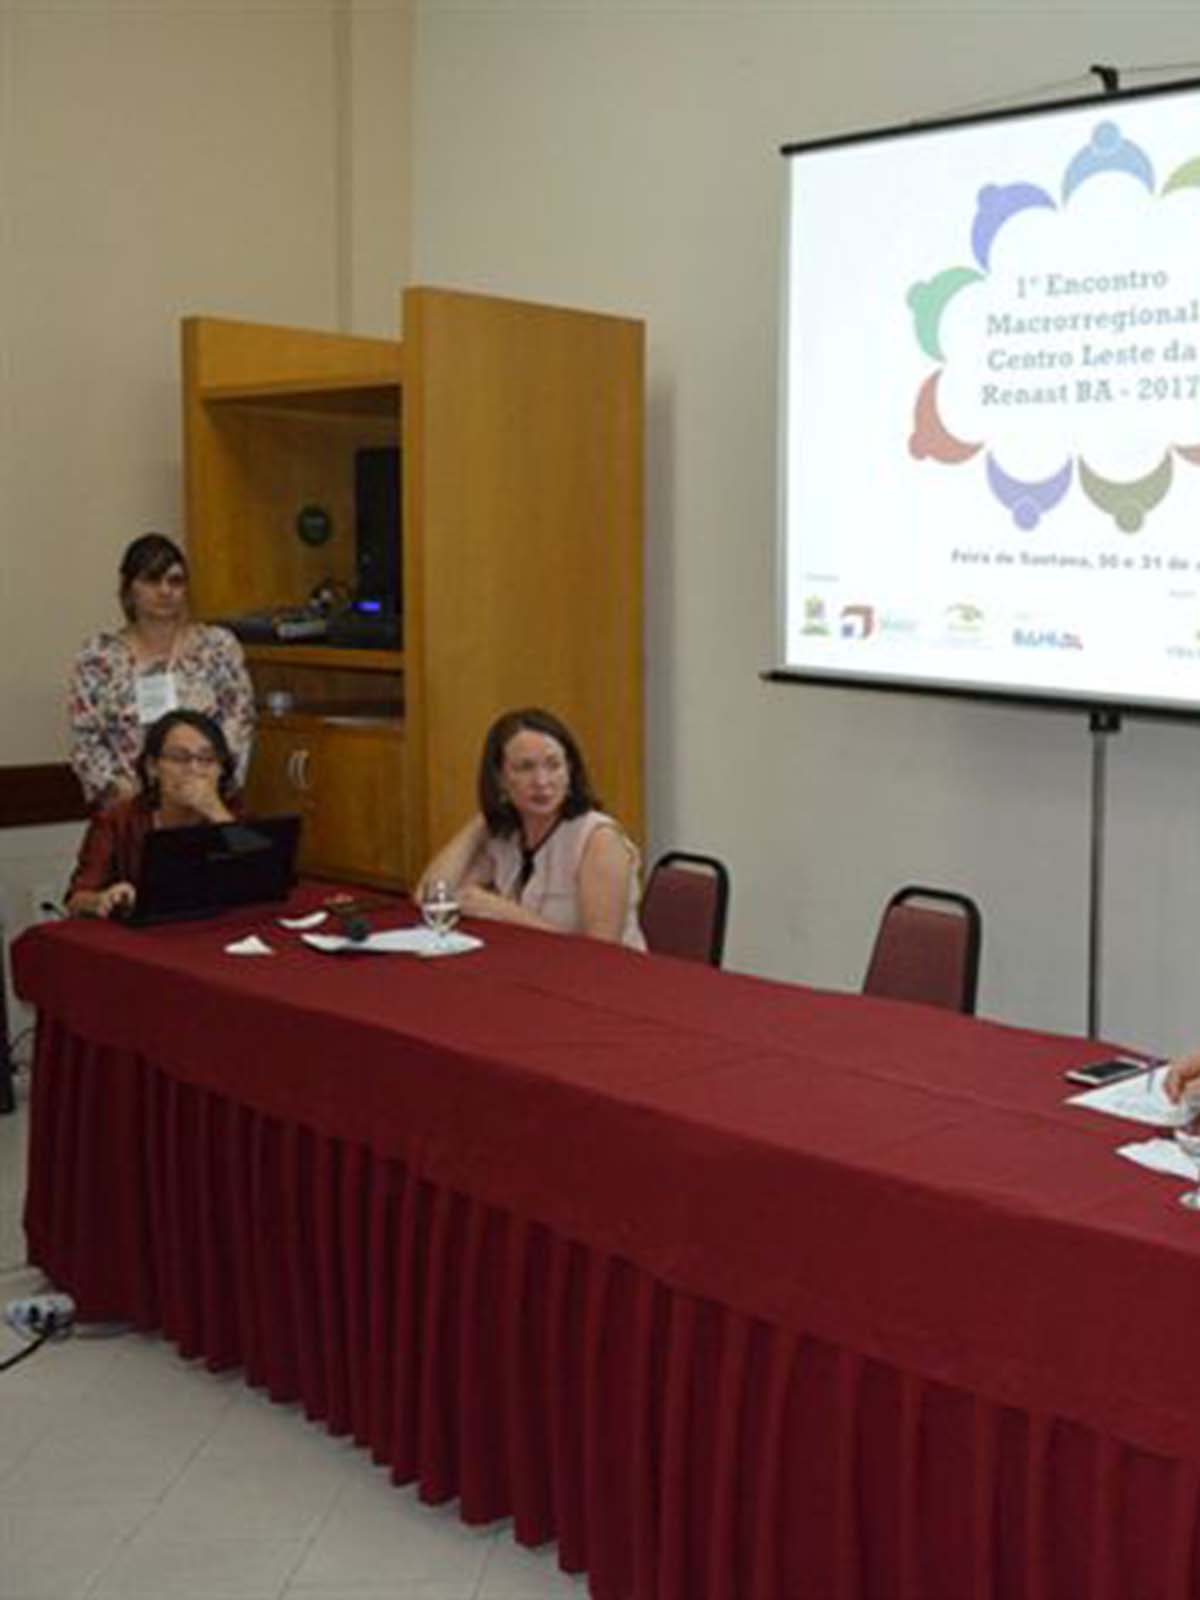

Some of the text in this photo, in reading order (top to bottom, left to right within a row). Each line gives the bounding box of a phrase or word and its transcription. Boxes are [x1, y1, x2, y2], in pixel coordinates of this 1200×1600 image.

[1046, 270, 1168, 297] Encontro
[986, 300, 1199, 336] Macrorregional
[987, 339, 1197, 372] Centro Leste da
[981, 383, 1069, 407] Renast
[1075, 379, 1113, 403] BA
[1137, 374, 1200, 401] 2017
[951, 548, 990, 565] Feira
